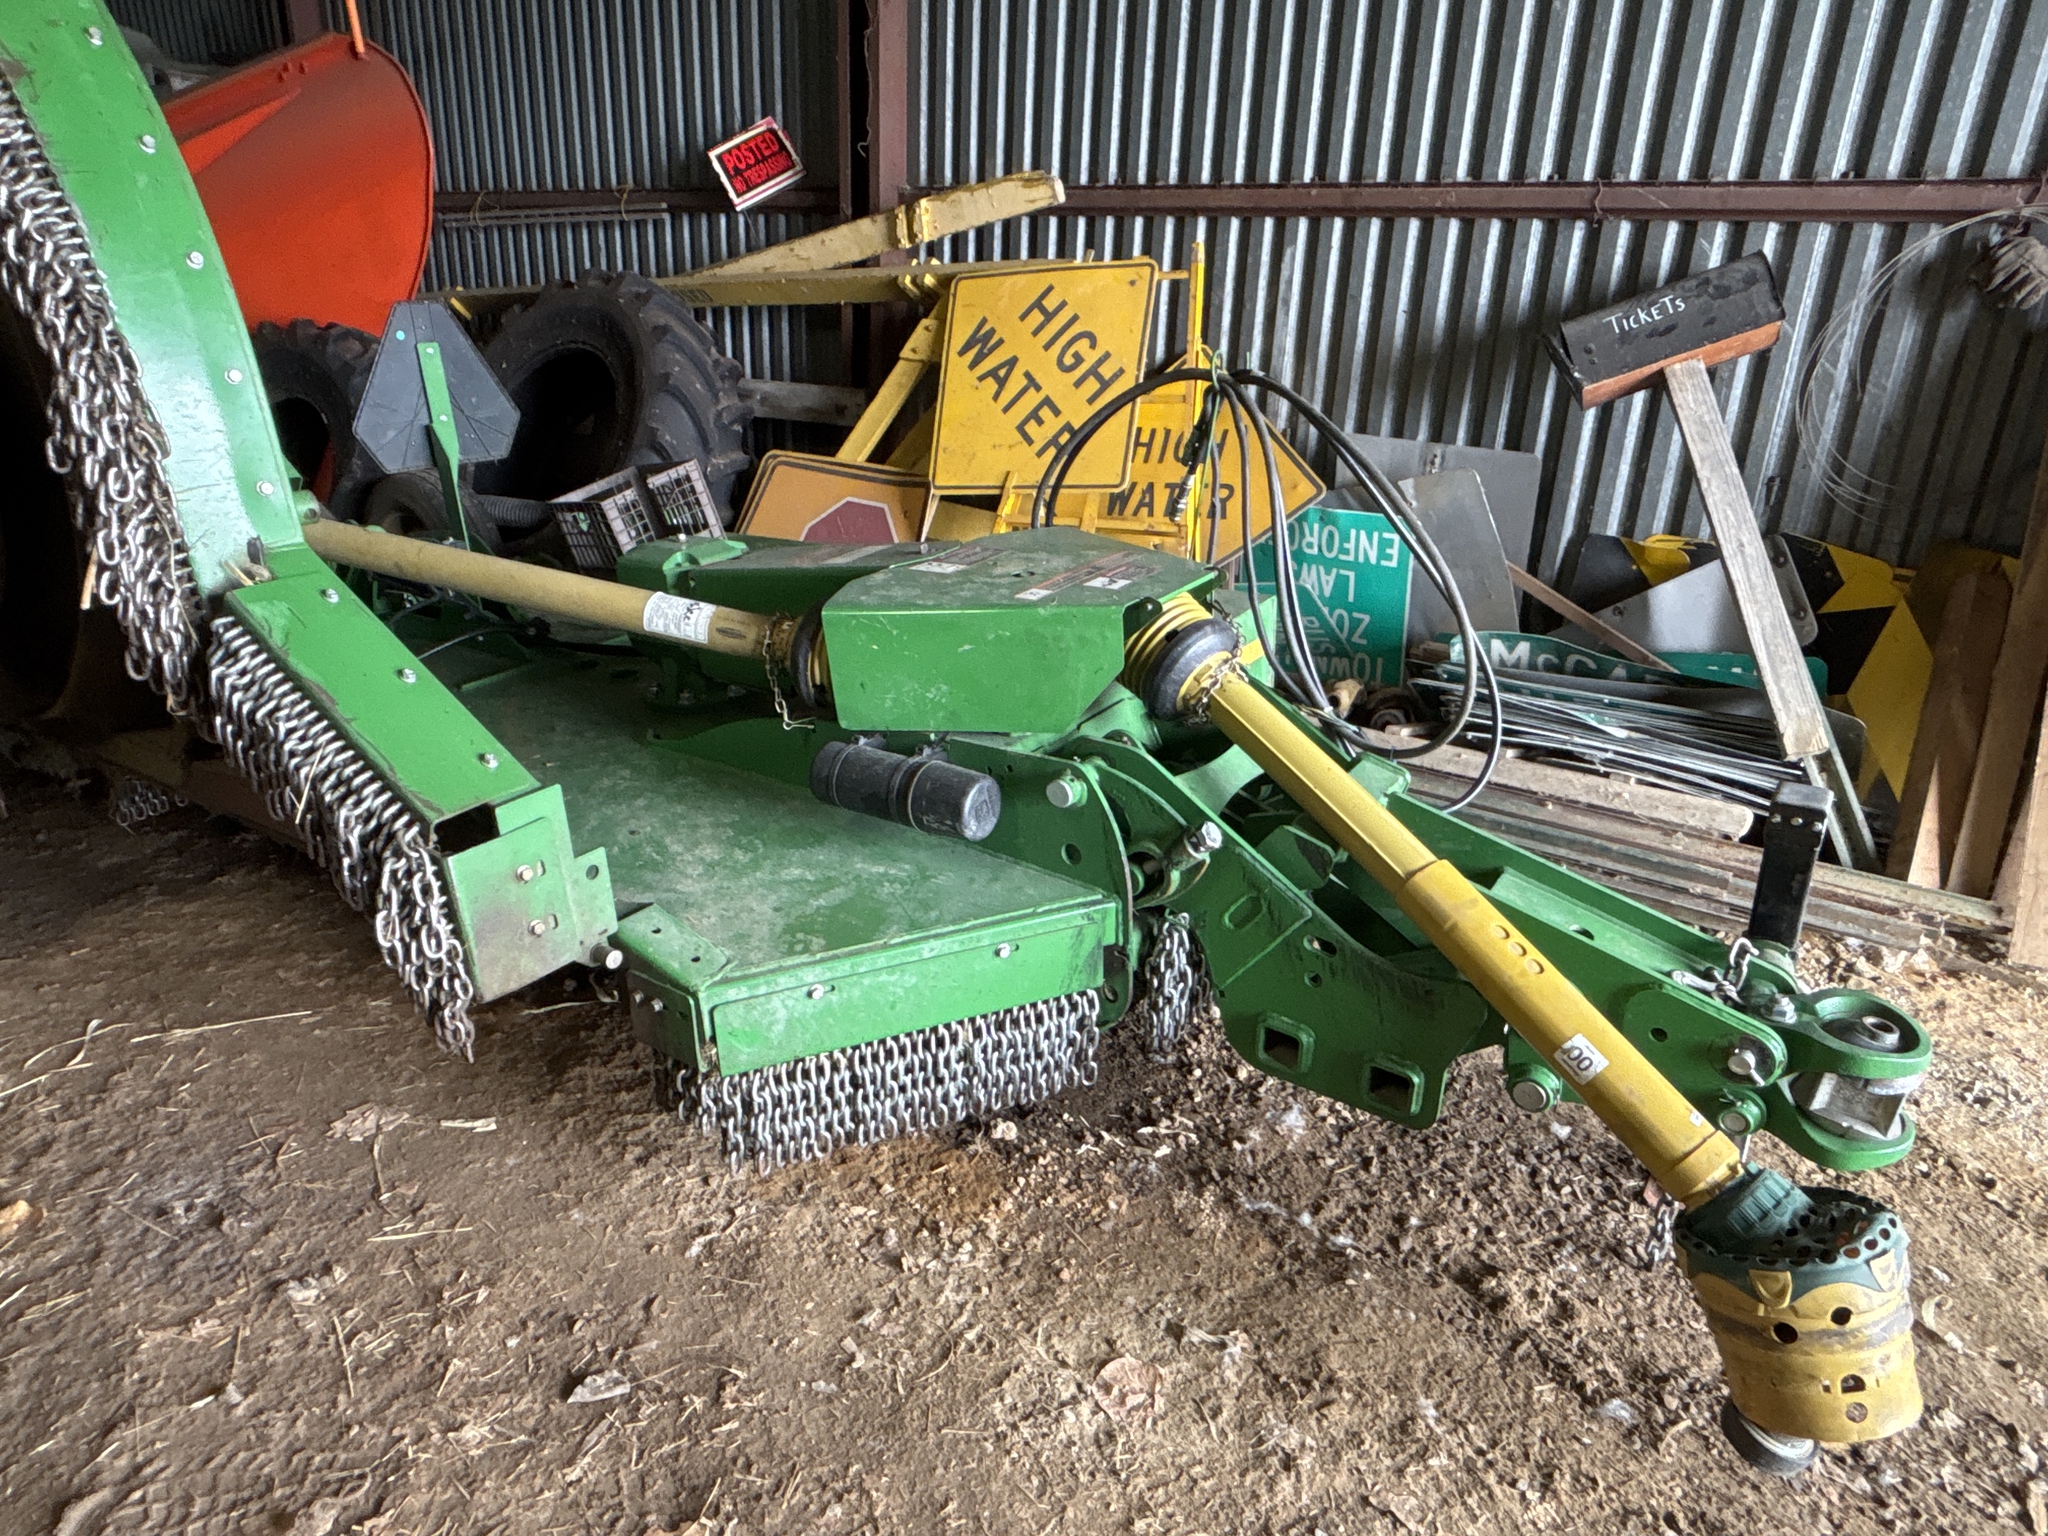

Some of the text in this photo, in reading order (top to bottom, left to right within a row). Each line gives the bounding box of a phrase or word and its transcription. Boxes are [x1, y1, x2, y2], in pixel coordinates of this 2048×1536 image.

[721, 131, 779, 175] POSTED
[731, 175, 747, 193] NO
[1018, 283, 1126, 406] HIGH
[957, 315, 1078, 459] WATER
[1107, 481, 1235, 519] WATR
[1287, 519, 1401, 569] ENFORC
[1291, 560, 1356, 603] LAW
